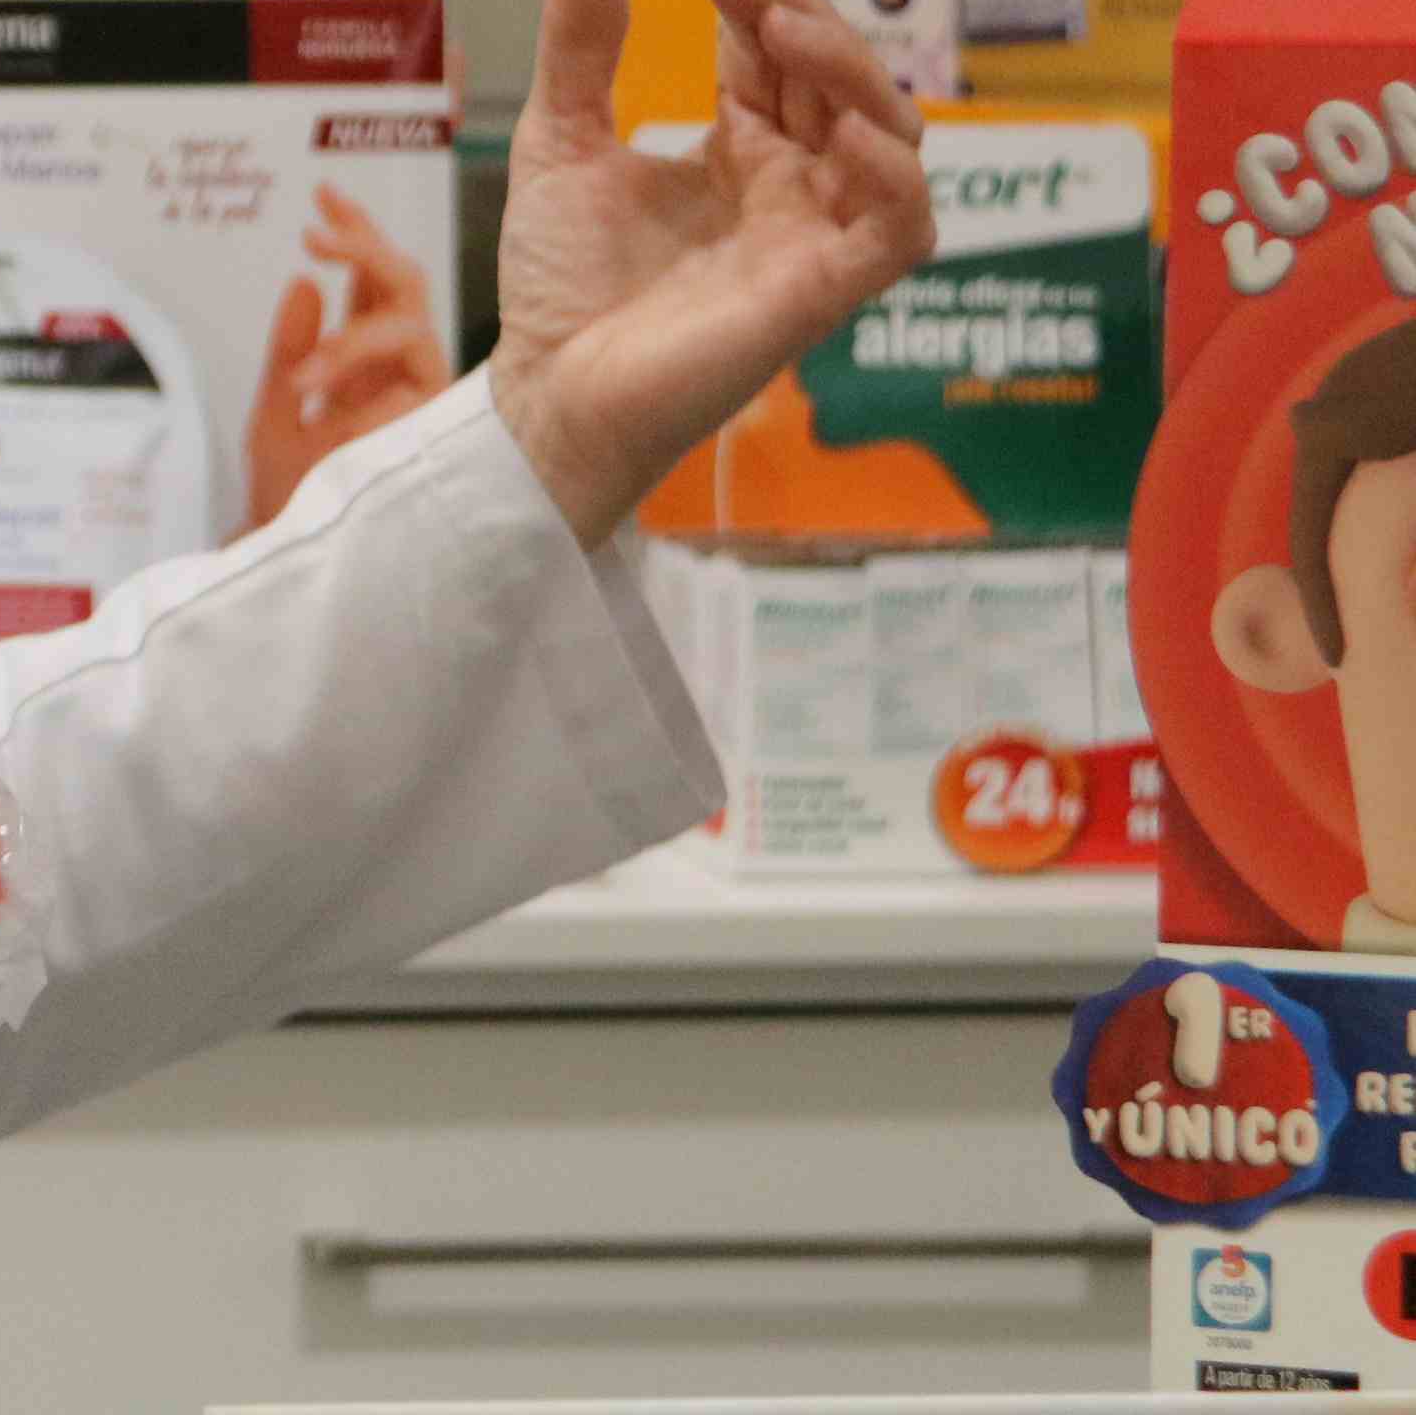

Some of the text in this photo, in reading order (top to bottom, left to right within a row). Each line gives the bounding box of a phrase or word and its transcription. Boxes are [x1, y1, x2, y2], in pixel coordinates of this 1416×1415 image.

[331, 120, 436, 151] NUEVA
[853, 306, 1100, 379] alergias
[1083, 1106, 1111, 1144] Y
[1204, 1365, 1217, 1384] A
[1218, 1368, 1253, 1390] partir
[1257, 1370, 1275, 1388] de
[1279, 1370, 1296, 1390] 12
